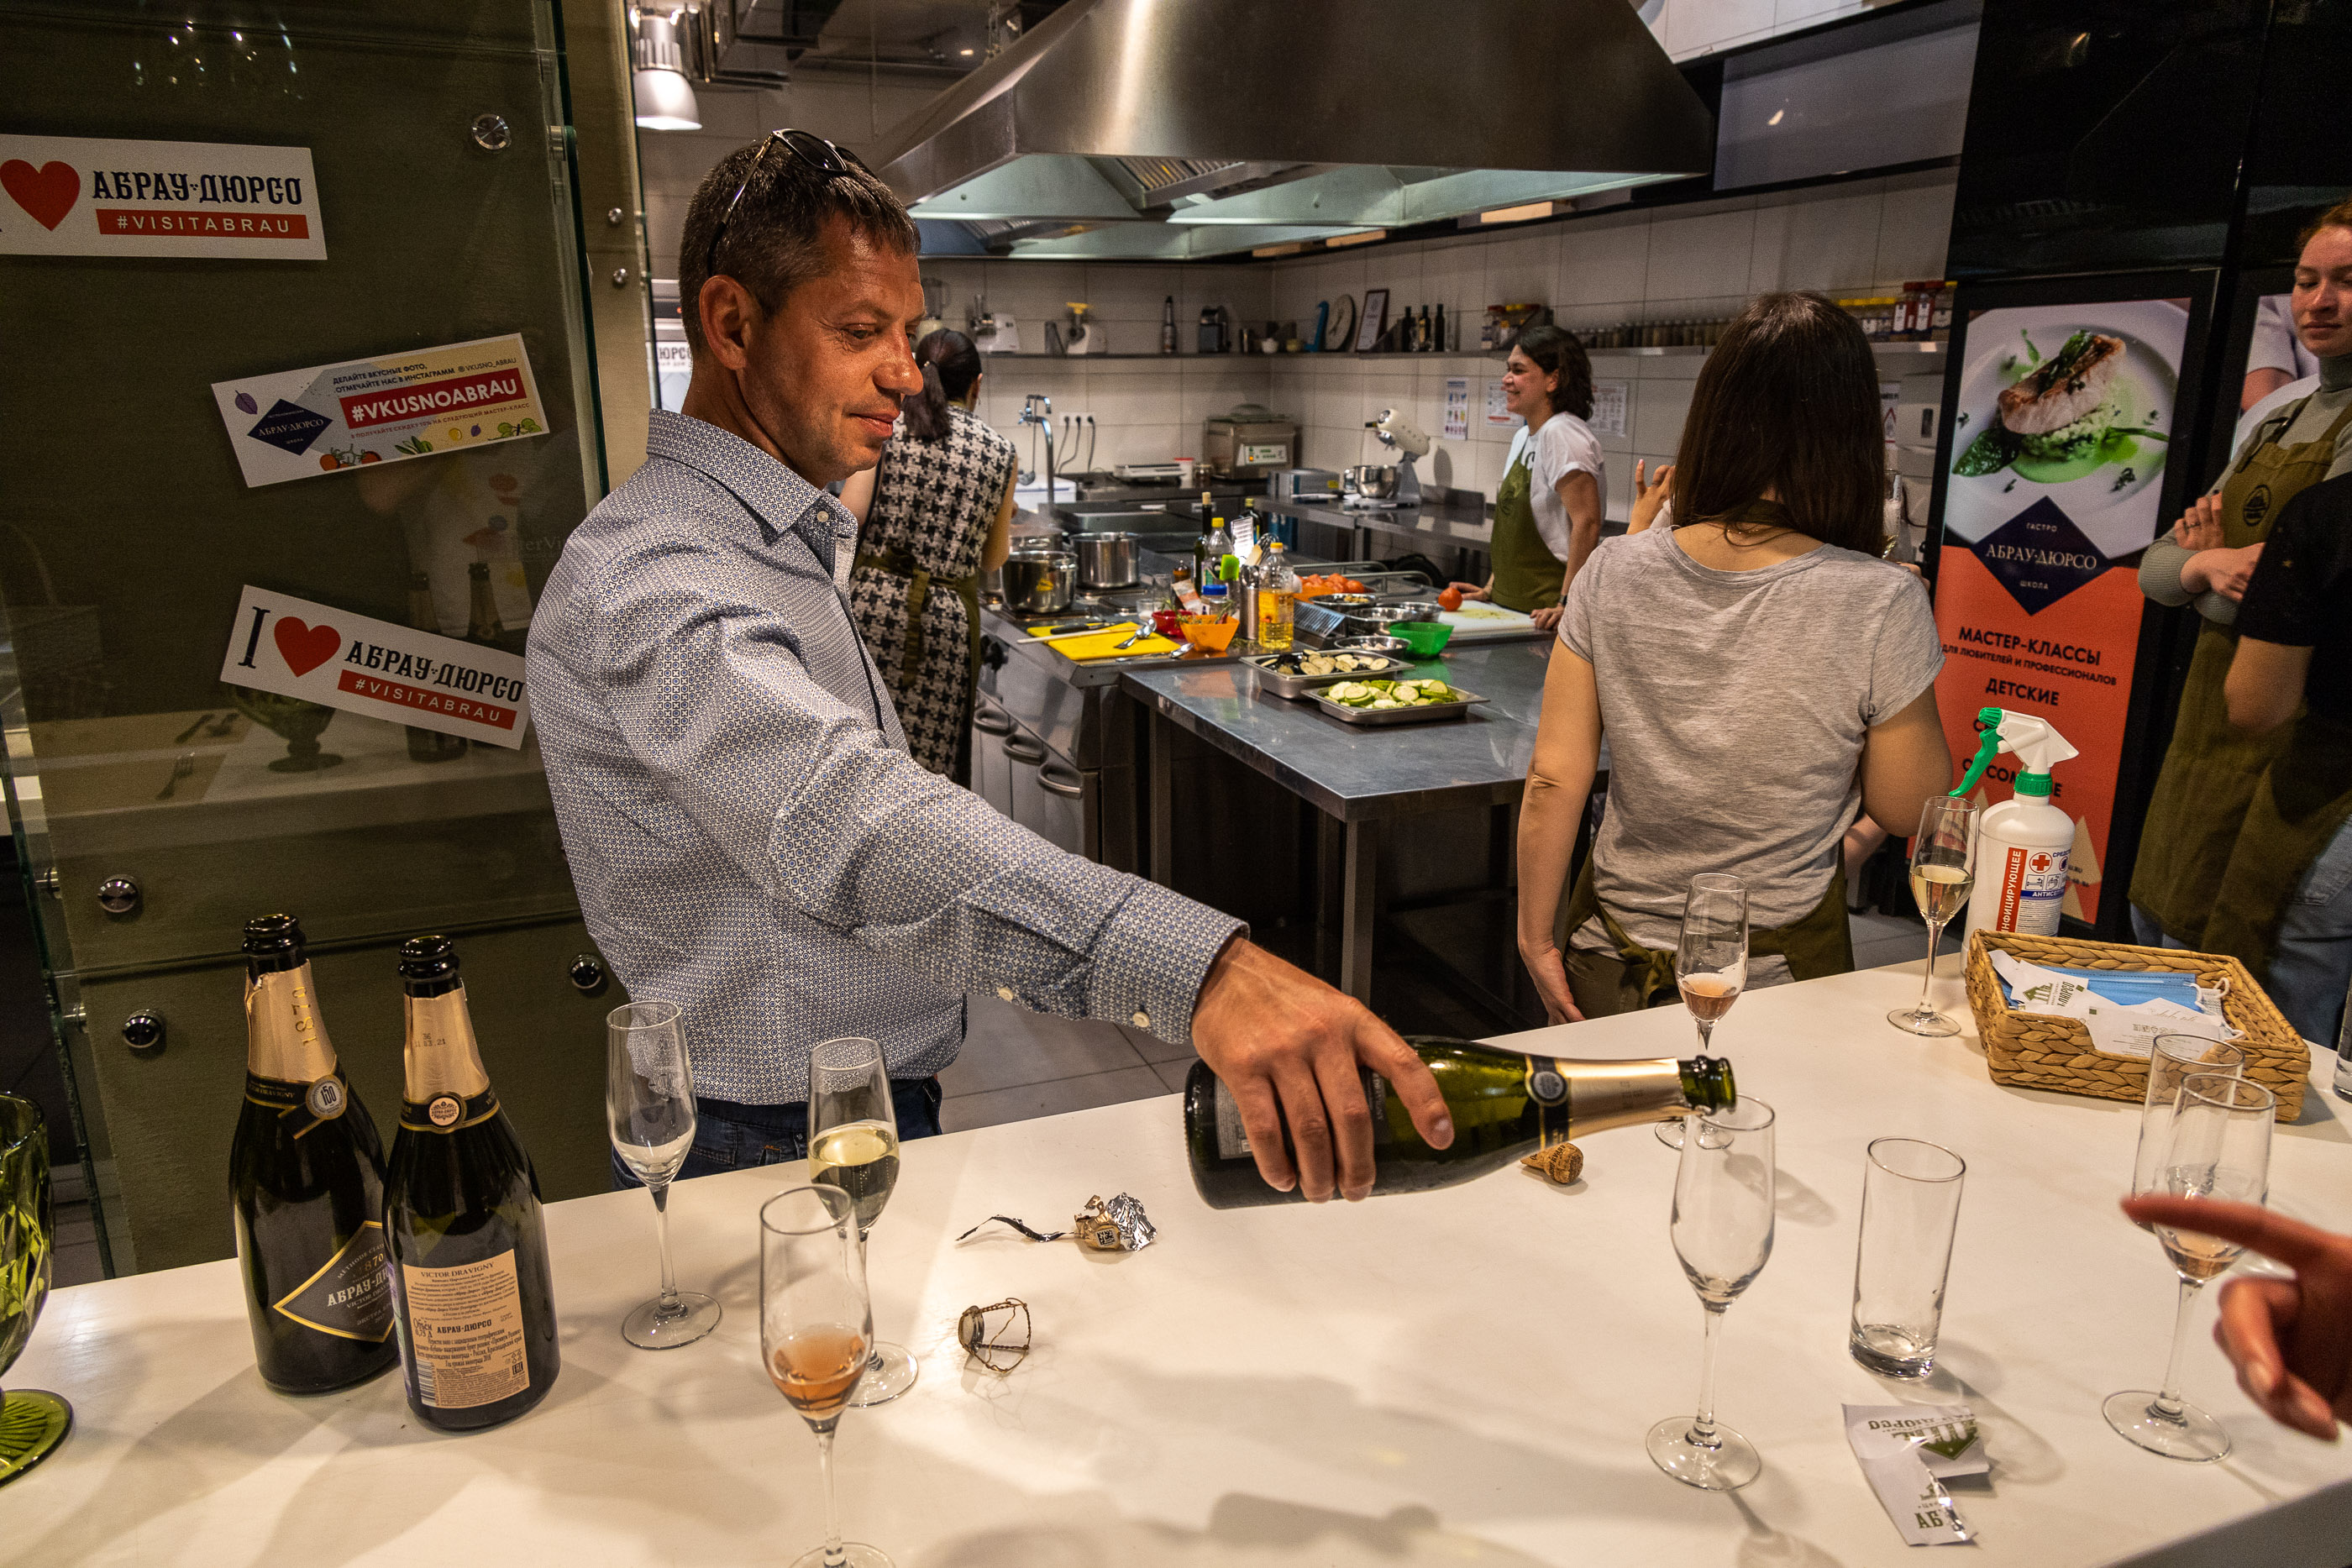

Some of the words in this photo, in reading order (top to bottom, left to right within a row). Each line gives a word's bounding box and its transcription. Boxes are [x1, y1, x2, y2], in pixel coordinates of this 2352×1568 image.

[117, 215, 289, 233] #VISITABRAU
[333, 373, 367, 385] ДЕЛАЙТЕ
[368, 367, 402, 378] ВКУСНЫЕ
[336, 380, 381, 393] ОТМЕЧАЙТЕ
[381, 377, 397, 385] НАС
[405, 368, 455, 382] ИНСТАГРАММ
[351, 379, 517, 422] #VKUSNOABRAU
[484, 403, 530, 416] МАСТЕР-КЛАСС
[2025, 522, 2057, 532] ГАСТРО
[2019, 579, 2049, 590] ШКОЛА
[238, 606, 270, 669] I
[1958, 626, 2101, 666] МАСТЕР-КЛАССЫ
[1941, 643, 1958, 654] ДЛЯ
[1959, 647, 2013, 665] ЛЮБИТЕЛЕЙ
[2014, 658, 2022, 667] И
[2023, 659, 2117, 685] ПРОФЕССИОНАЛОВ
[354, 679, 501, 721] #VISITABRAU
[1985, 678, 2061, 706] ДЕТСКИЕ
[451, 1262, 494, 1277] DRAVIGNY
[346, 1294, 372, 1308] VICTOR
